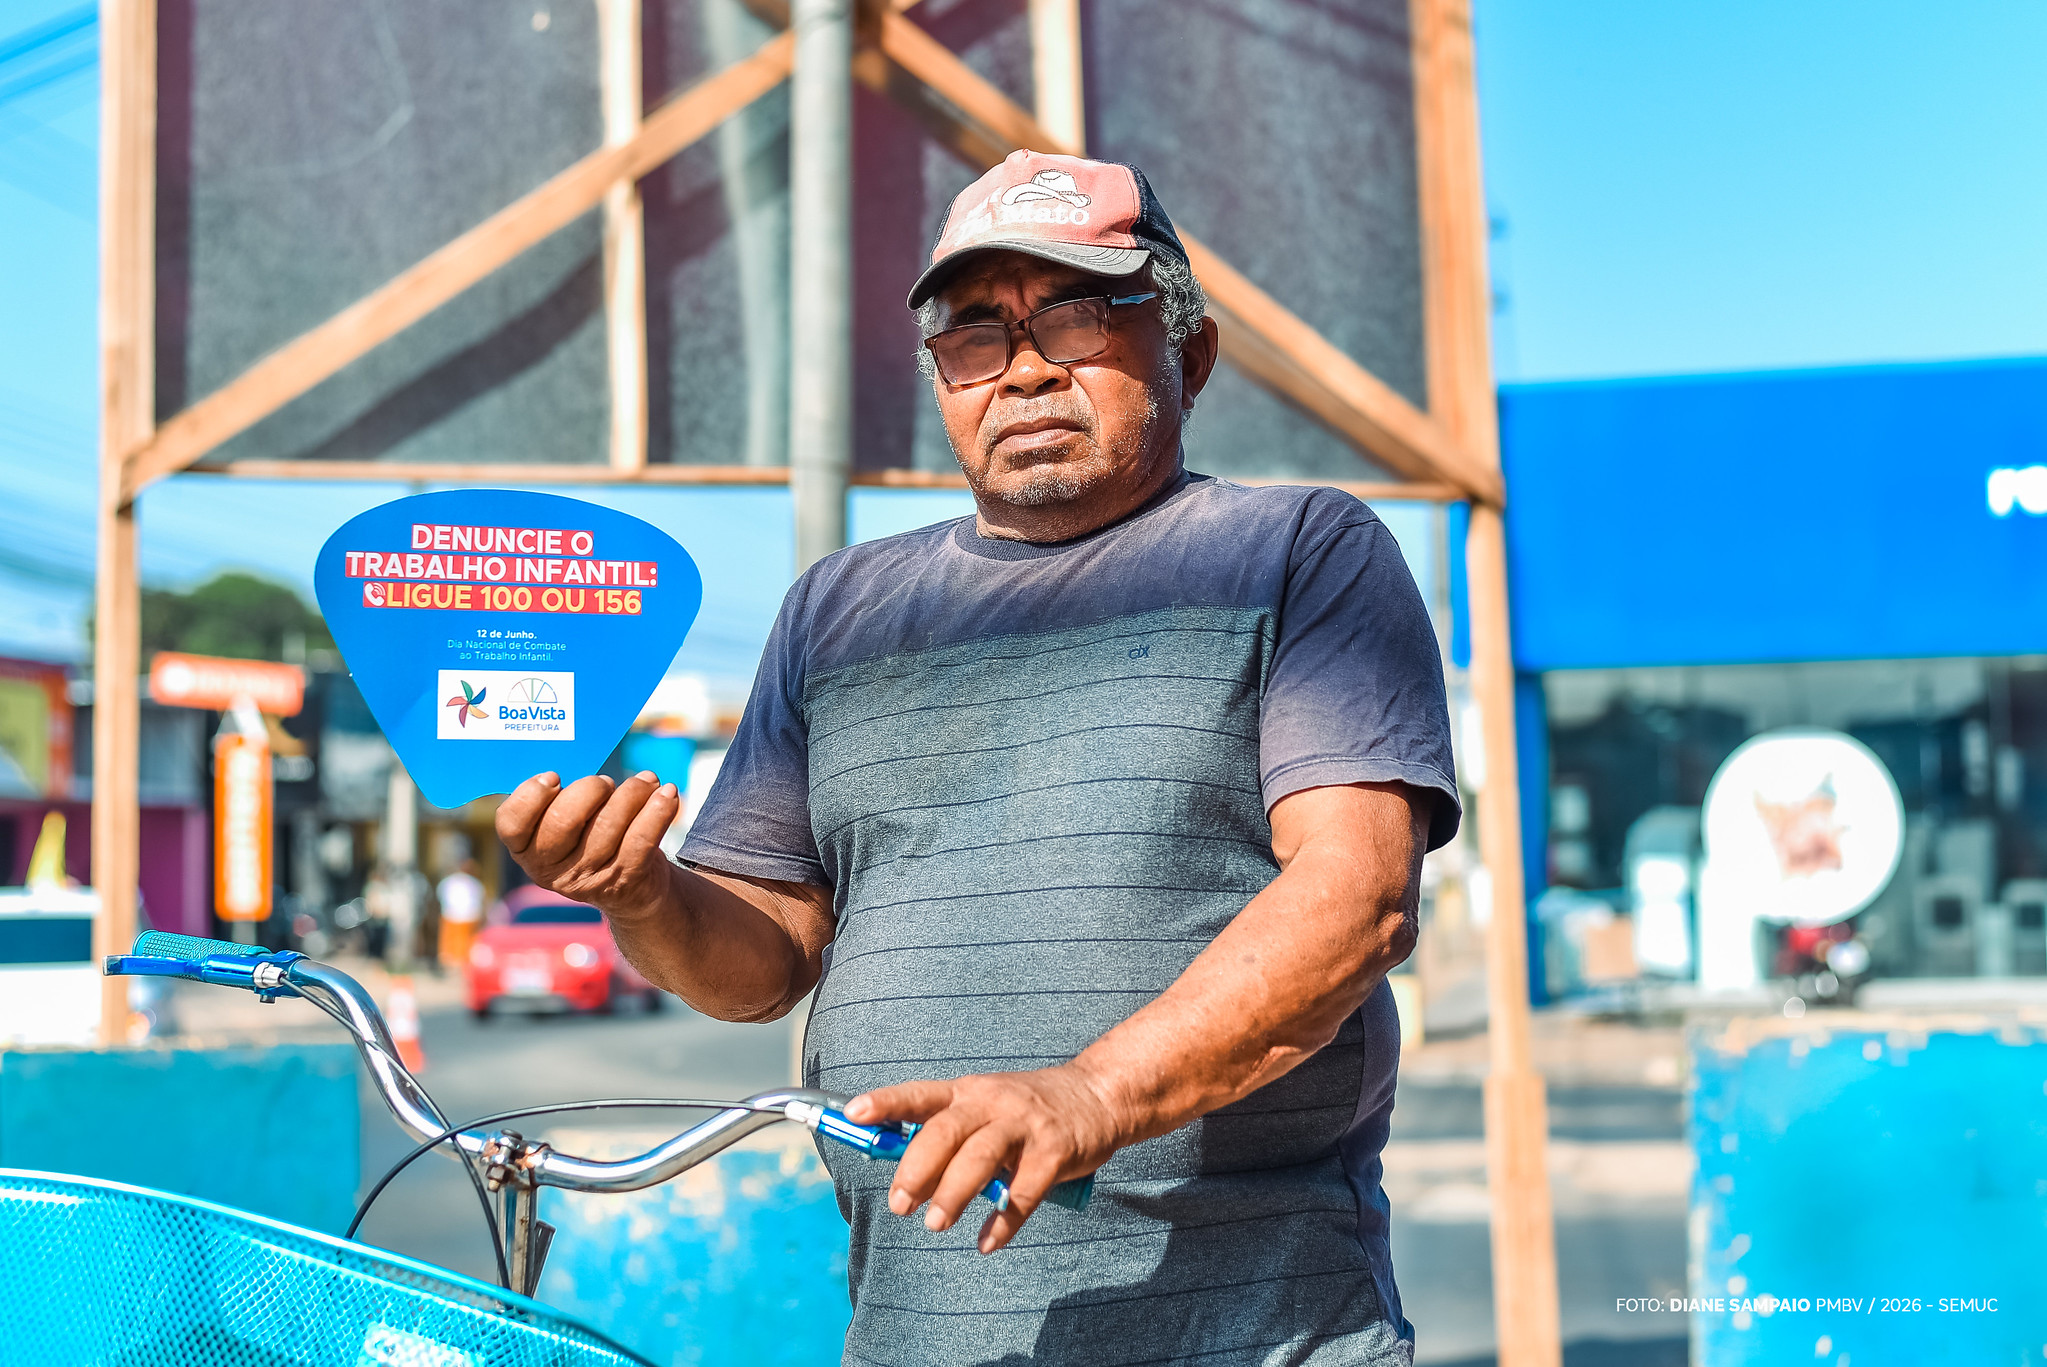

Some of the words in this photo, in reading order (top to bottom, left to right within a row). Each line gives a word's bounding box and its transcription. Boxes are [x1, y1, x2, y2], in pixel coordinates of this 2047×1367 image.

[412, 525, 562, 554] DENUNCIE
[570, 531, 593, 555] O
[345, 552, 507, 581] TRABALHO
[515, 558, 657, 587] INFANTIL:
[387, 584, 472, 610] LIGUE
[480, 586, 532, 611] 100
[541, 588, 585, 613] OU
[594, 590, 642, 615] 156
[476, 629, 488, 639] 12
[489, 630, 503, 639] de
[504, 630, 538, 640] Junho.
[447, 639, 463, 649] Dia
[465, 640, 507, 650] Nacional
[508, 641, 521, 650] de
[523, 641, 567, 651] Combate
[459, 651, 472, 660] ao
[474, 651, 517, 661] Trabalho
[519, 652, 554, 662] Infantil.
[504, 723, 560, 731] PREFEITURA
